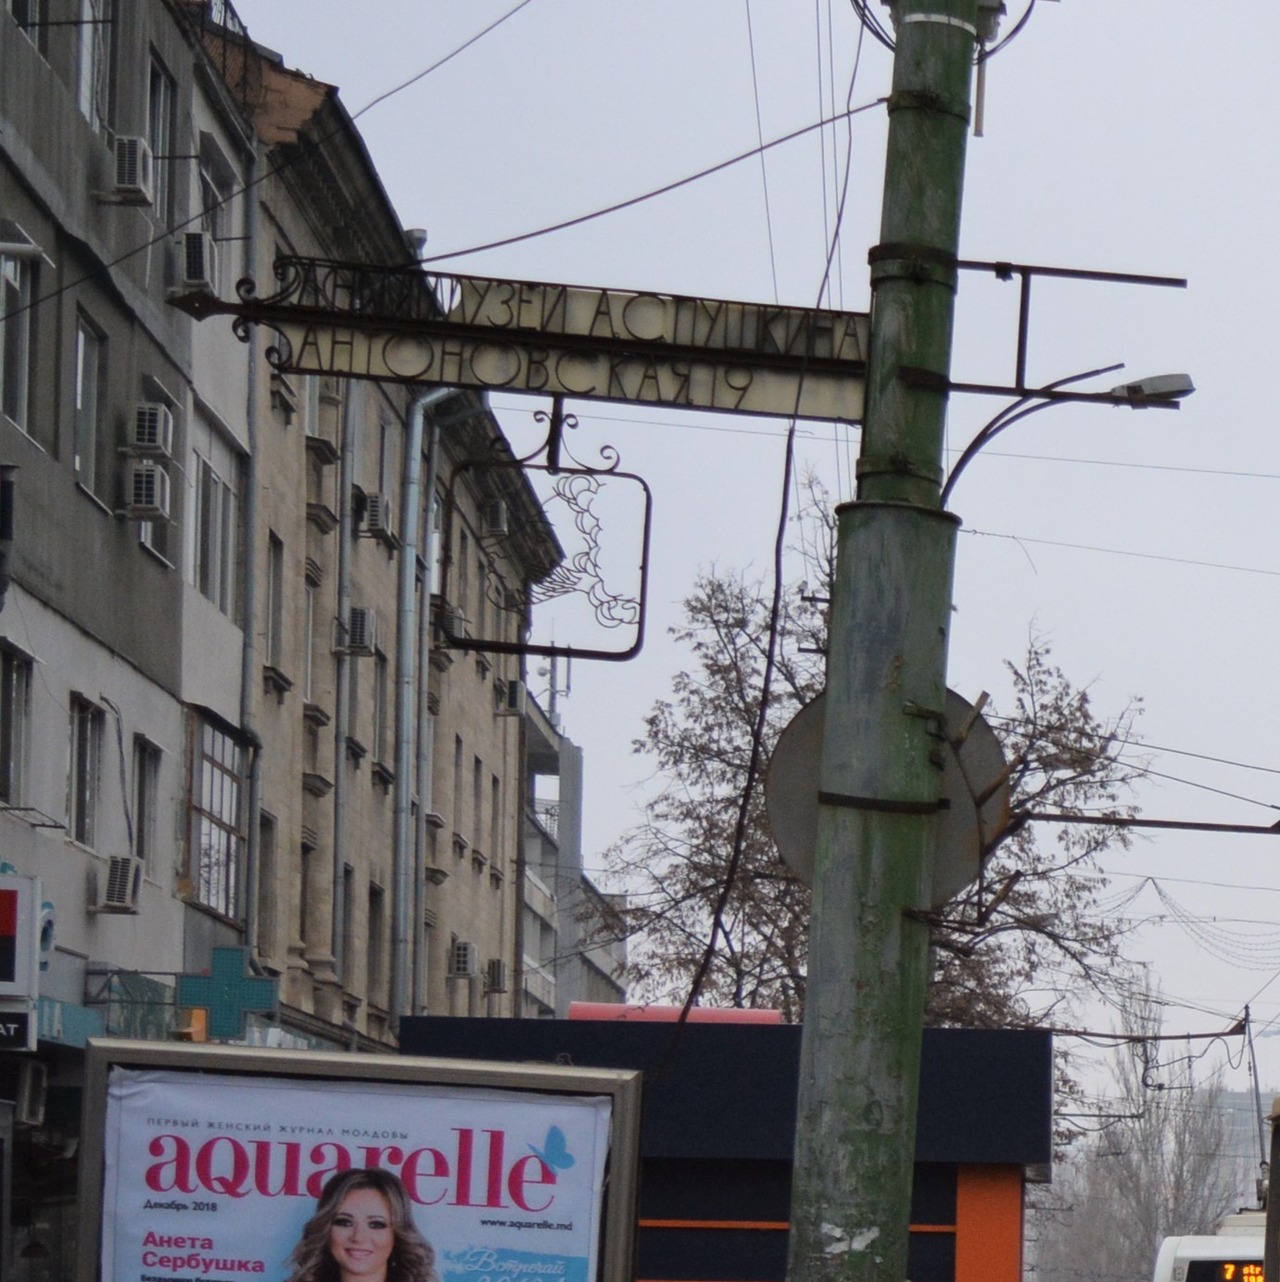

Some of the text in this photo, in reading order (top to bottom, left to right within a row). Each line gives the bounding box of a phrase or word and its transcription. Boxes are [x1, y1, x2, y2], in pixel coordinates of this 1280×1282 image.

[147, 1117, 409, 1140] ПЕРВЫЙ ЖЕНСКИЙ ЖУРНАЛ МОЛДОВЫ
[143, 1199, 218, 1212] Декабрь 2018
[480, 1217, 573, 1231] www.aquarelle.md
[143, 1231, 213, 1250] Анета
[142, 1251, 265, 1273] Сербушка
[1223, 1264, 1236, 1280] 7
